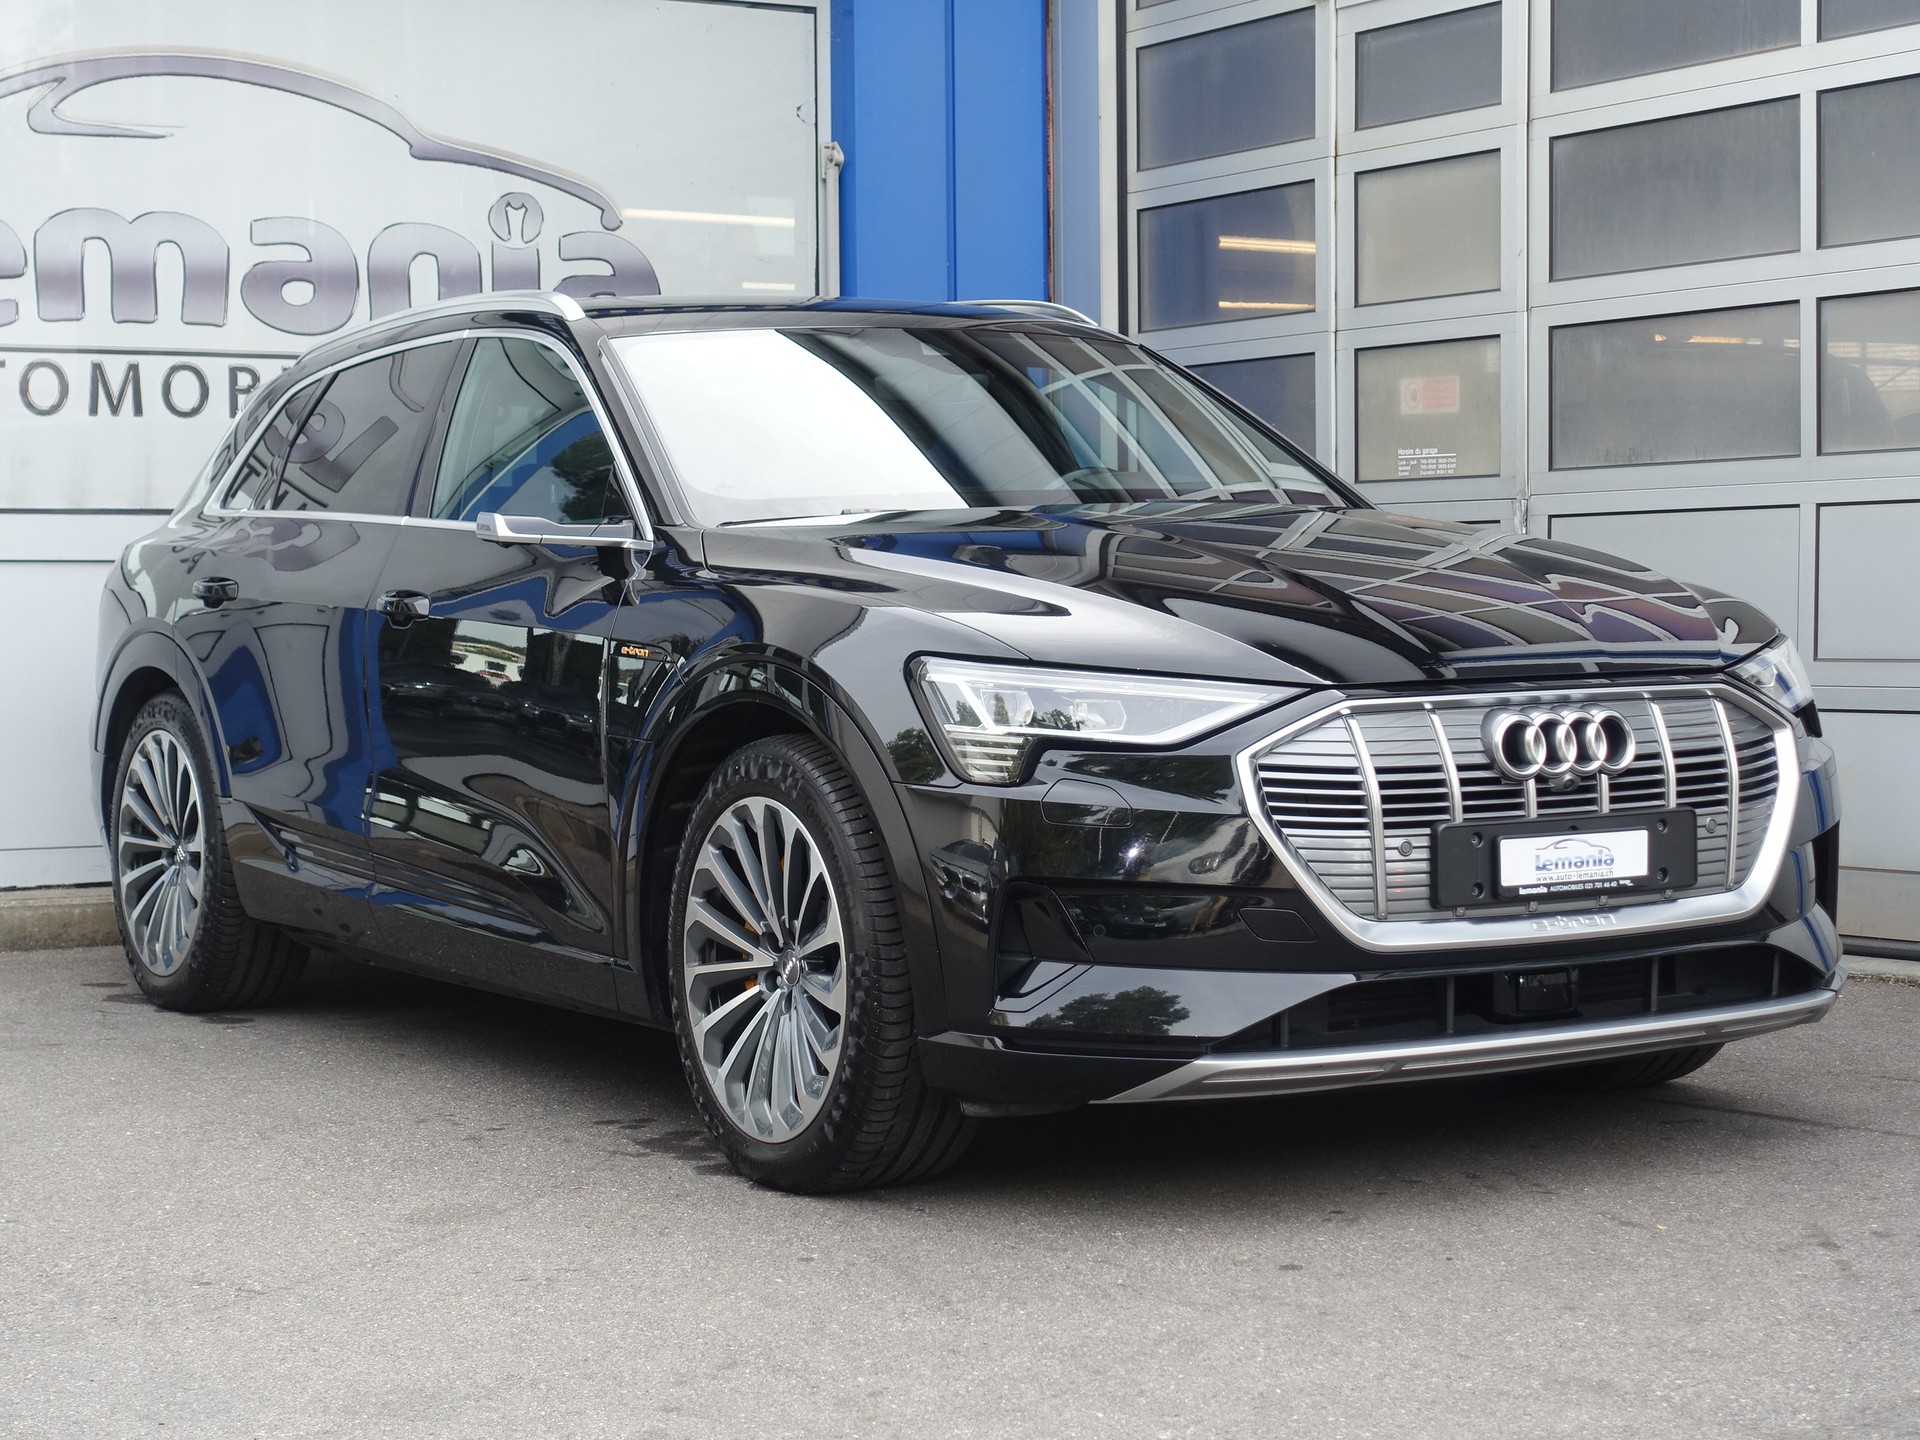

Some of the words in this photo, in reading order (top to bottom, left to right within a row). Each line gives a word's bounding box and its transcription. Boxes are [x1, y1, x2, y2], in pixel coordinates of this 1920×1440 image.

[0, 192, 661, 335] mania
[621, 646, 649, 657] e-tron
[1535, 849, 1614, 871] Lemania
[1536, 870, 1614, 882] www.auto-lemania.ch
[1550, 883, 1584, 892] AUTOMOBILES
